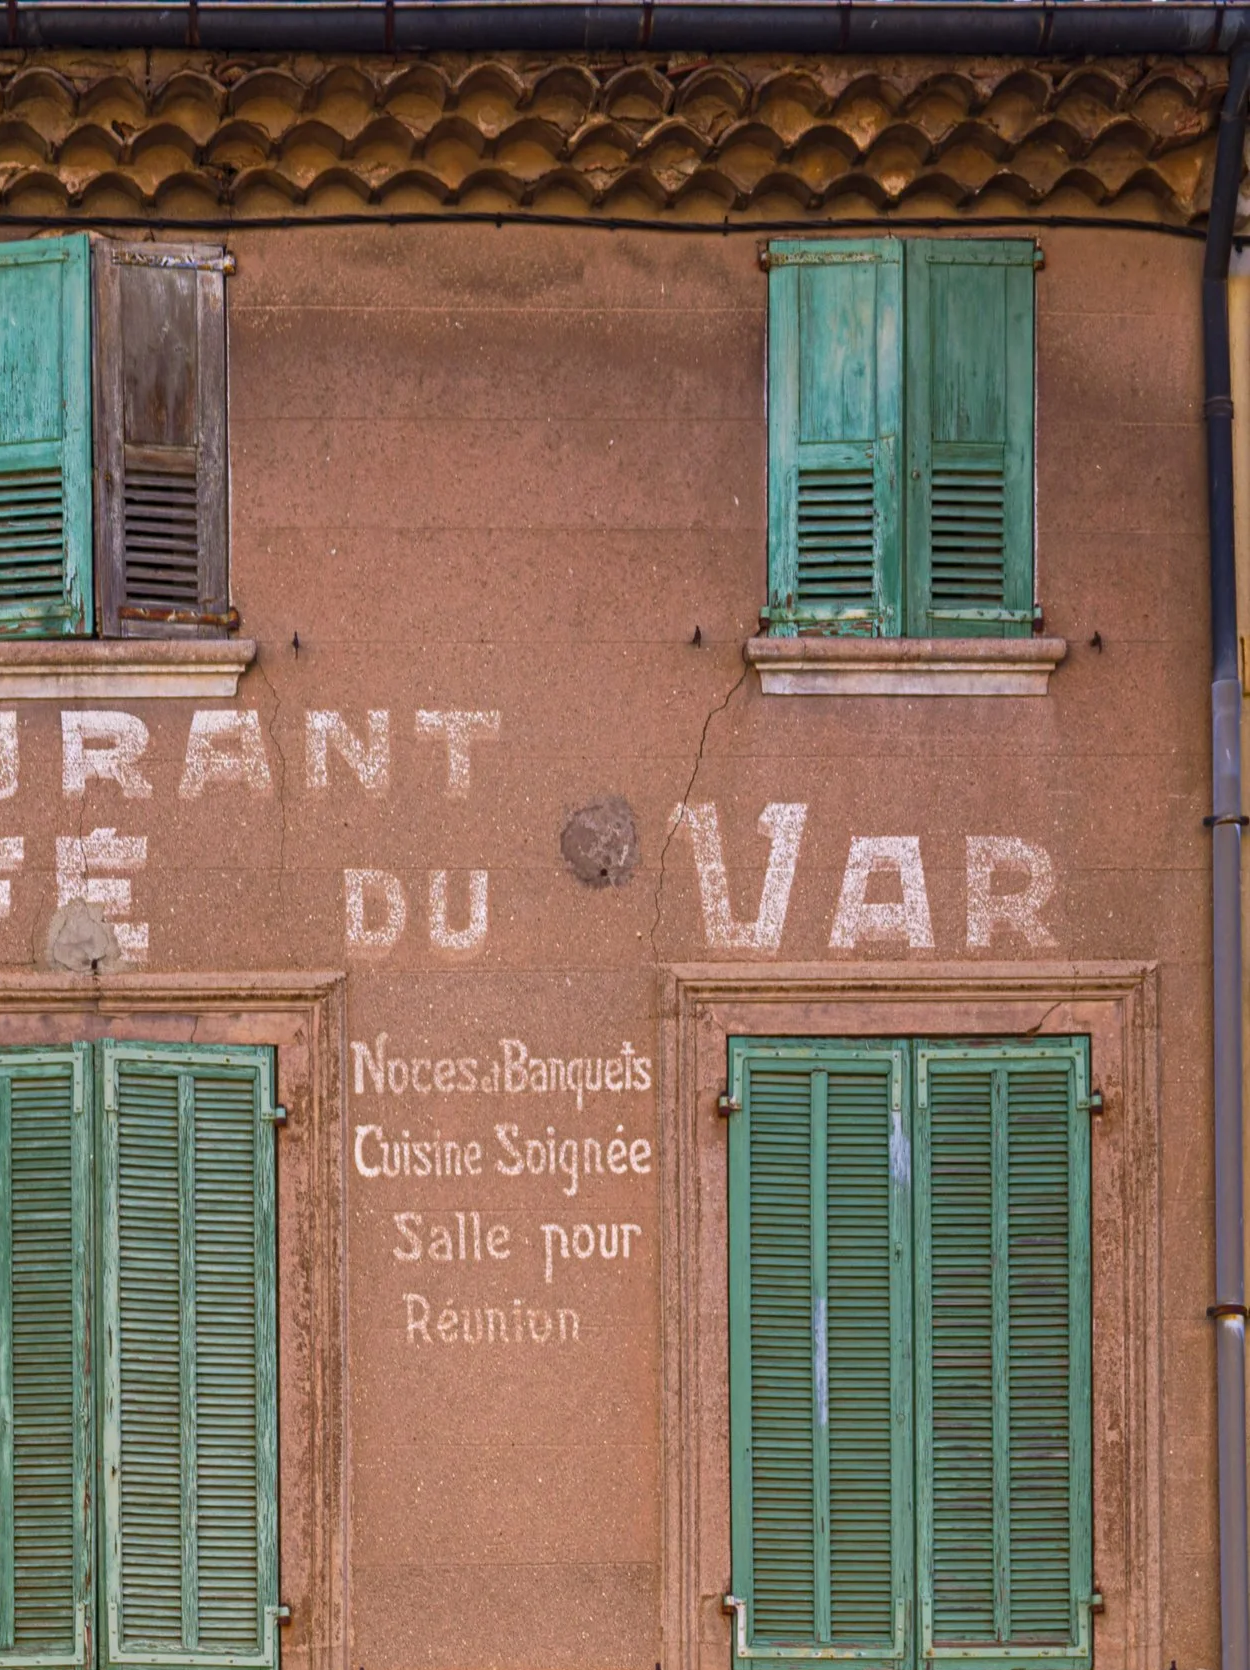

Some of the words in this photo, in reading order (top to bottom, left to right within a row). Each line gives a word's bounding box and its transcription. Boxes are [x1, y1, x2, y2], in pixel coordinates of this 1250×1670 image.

[344, 868, 488, 953] DU
[669, 802, 1057, 952] VAR
[351, 1032, 477, 1094] Noces
[500, 1039, 652, 1110] Banquets
[354, 1124, 482, 1177] Cuisine
[494, 1121, 652, 1196] Soignée
[392, 1211, 511, 1261] Salle
[540, 1223, 642, 1284] pour
[402, 1293, 580, 1344] Réunion
